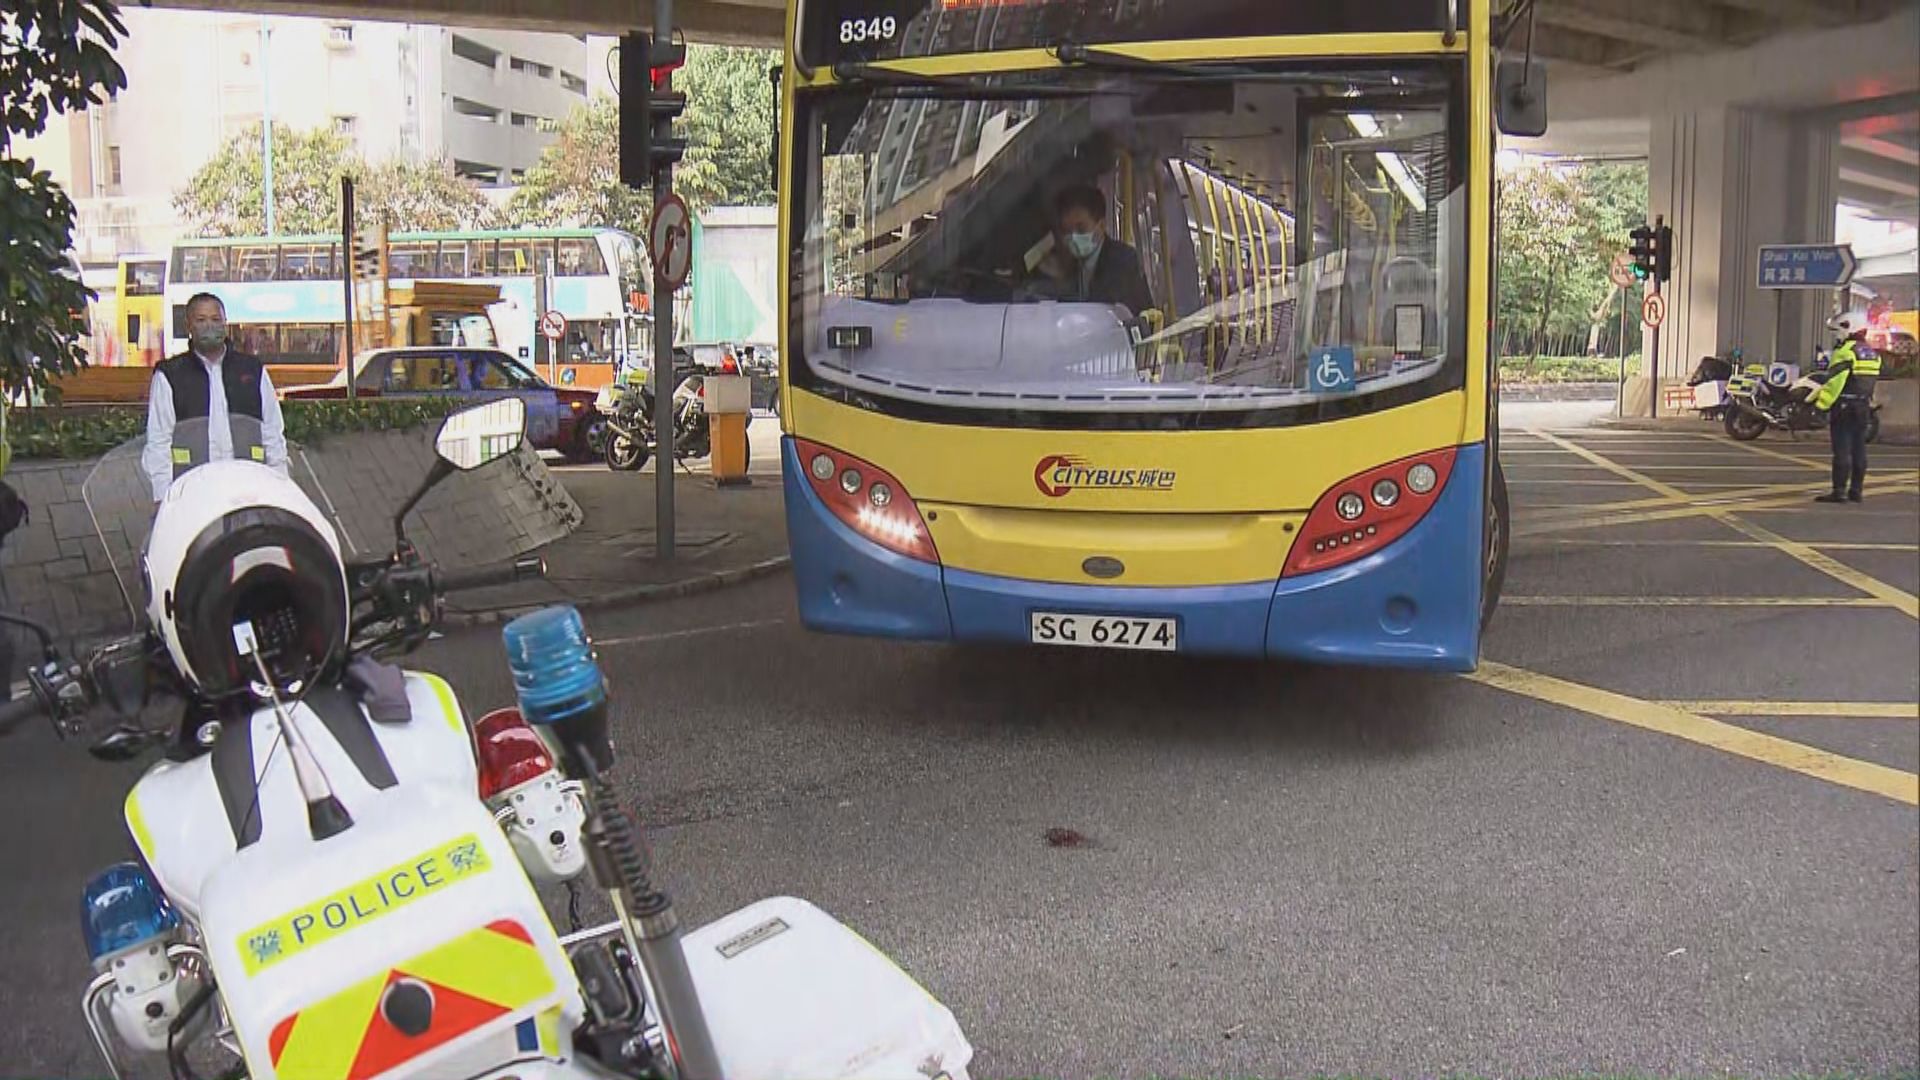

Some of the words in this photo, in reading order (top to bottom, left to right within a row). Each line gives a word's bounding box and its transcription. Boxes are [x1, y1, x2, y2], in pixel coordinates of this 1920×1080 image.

[840, 16, 896, 43] 8349
[1053, 468, 1136, 485] CITYBUS
[1039, 616, 1077, 641] SG
[1091, 619, 1170, 647] 6274
[291, 857, 444, 944] POLICE
